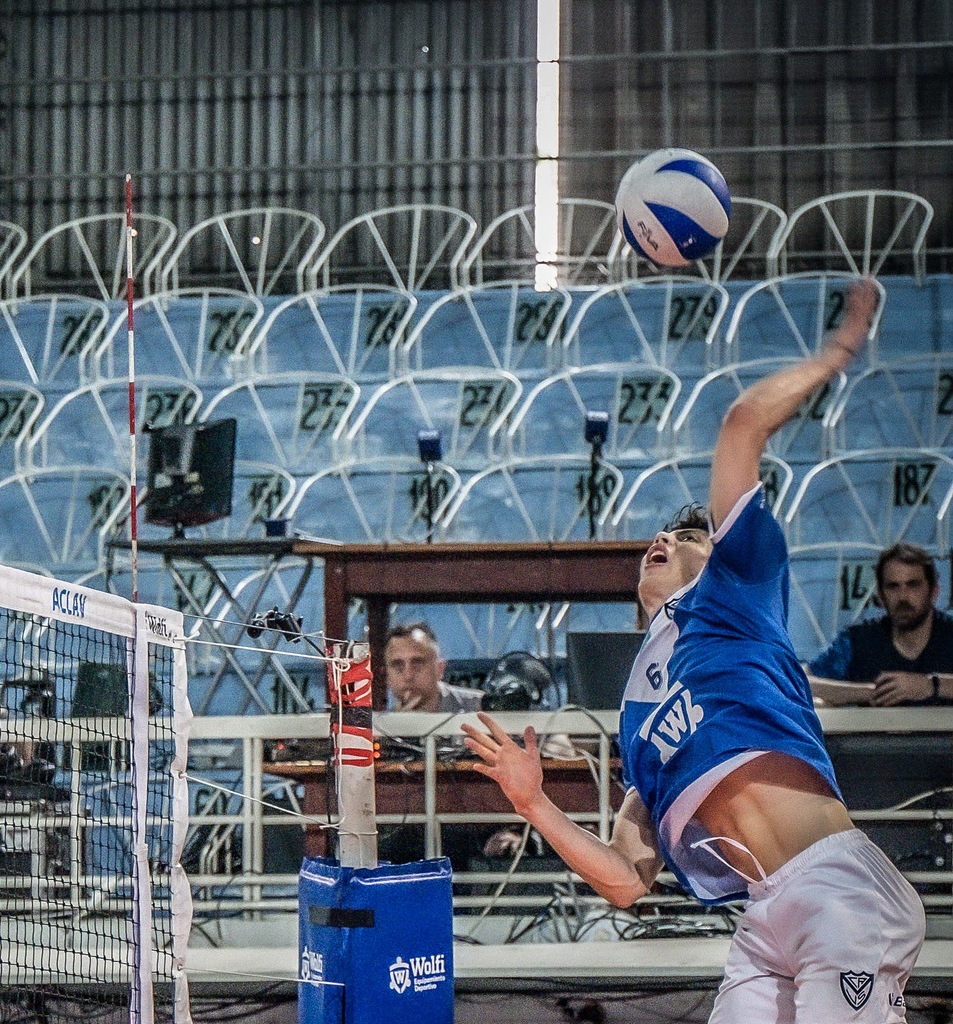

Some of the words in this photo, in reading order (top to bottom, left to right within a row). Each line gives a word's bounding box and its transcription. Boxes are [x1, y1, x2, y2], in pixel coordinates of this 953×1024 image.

[893, 463, 937, 507] 187
[52, 587, 87, 618] ACLAV
[646, 663, 663, 690] 6
[410, 954, 445, 977] Wolfi
